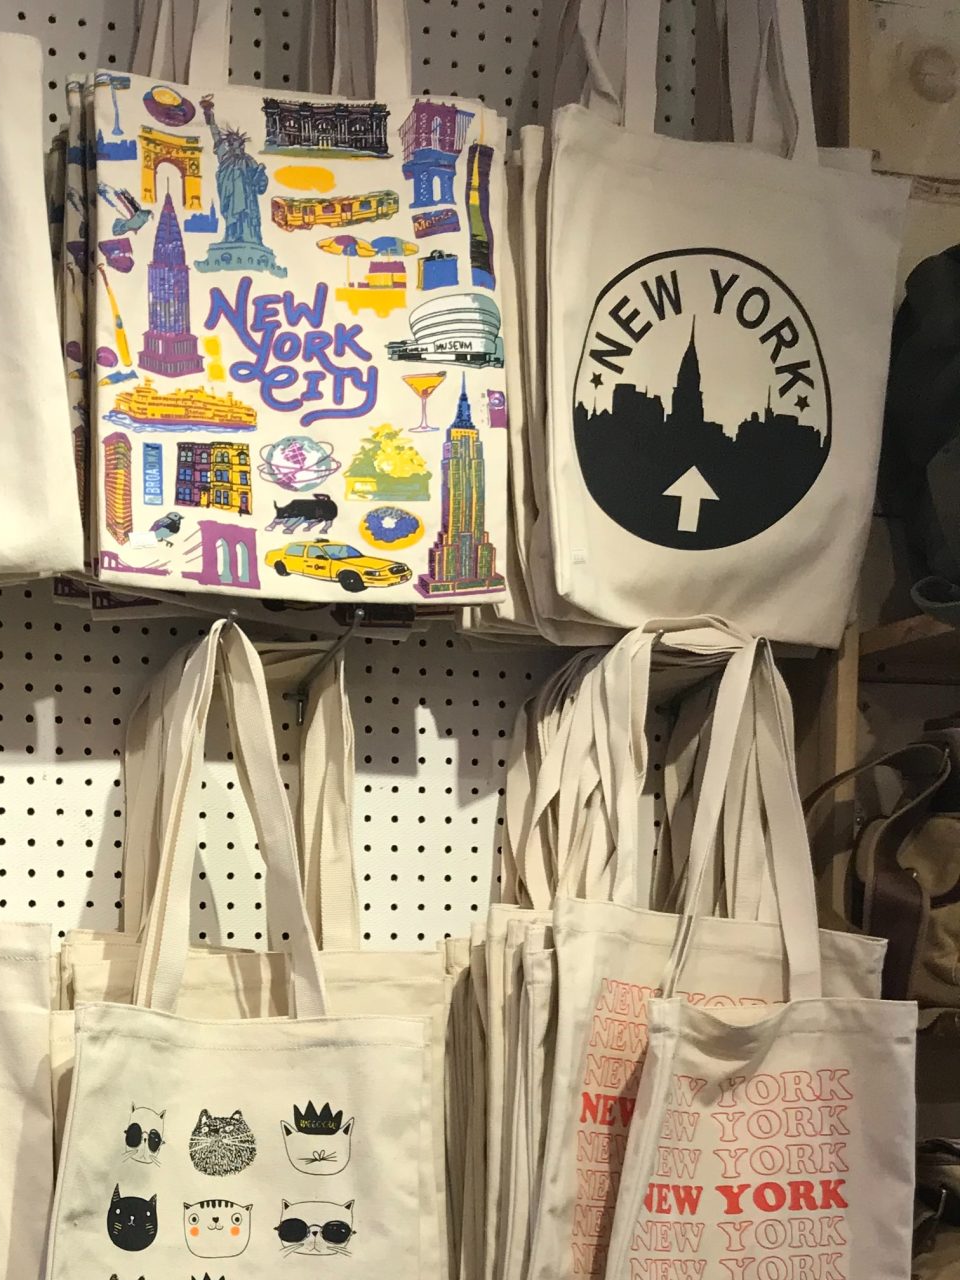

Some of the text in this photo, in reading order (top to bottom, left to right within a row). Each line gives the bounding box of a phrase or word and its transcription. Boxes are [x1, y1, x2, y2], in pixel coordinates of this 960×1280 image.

[204, 276, 329, 355] NEW
[589, 268, 815, 398] NEW YORK
[229, 322, 373, 383] YORK
[259, 365, 379, 427] CITY
[717, 1069, 853, 1108] YORK
[660, 1105, 851, 1143] EW YORK
[656, 1142, 850, 1179] EW YORK
[715, 1178, 849, 1215] YORK
[572, 1204, 616, 1238] NE
[630, 1215, 847, 1253] NEW YORK
[571, 1242, 609, 1275] NE
